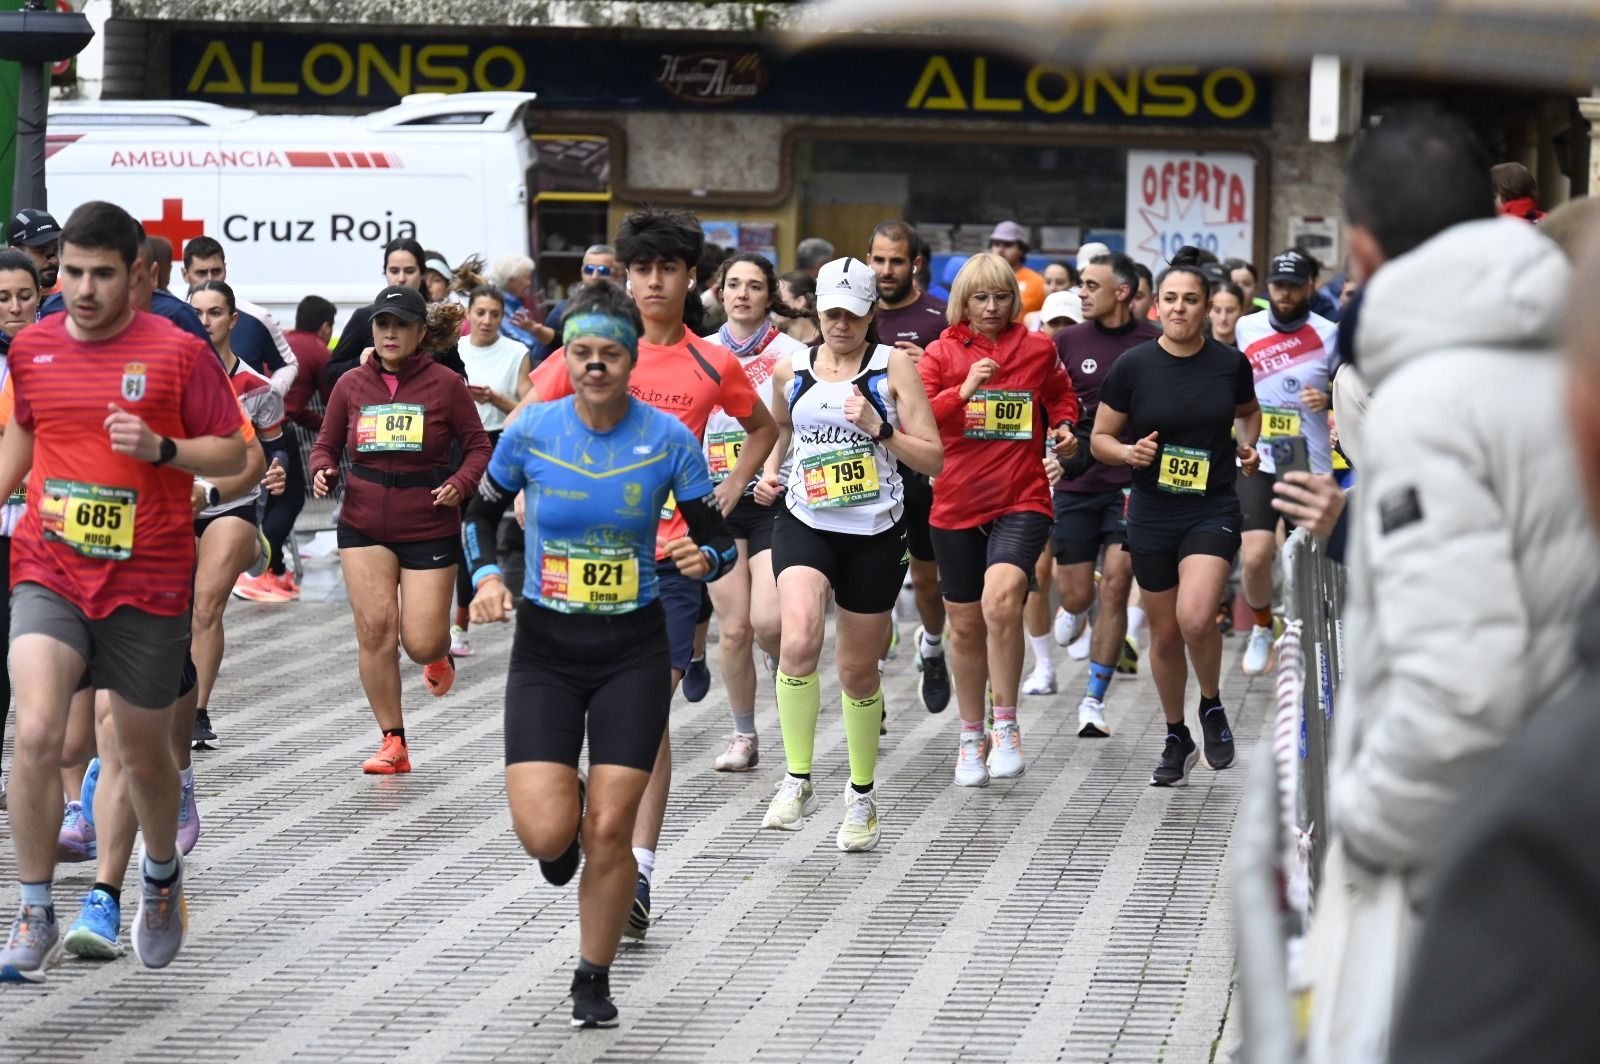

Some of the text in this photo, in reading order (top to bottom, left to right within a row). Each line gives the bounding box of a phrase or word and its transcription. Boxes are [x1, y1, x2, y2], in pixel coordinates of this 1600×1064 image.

[186, 40, 526, 97] ALONSO
[905, 55, 1256, 119] ALONSO
[110, 150, 283, 168] AMBULANCIA
[1142, 159, 1247, 224] OFERTA
[222, 211, 418, 248] Cruz Roja
[1261, 352, 1293, 374] FER
[995, 402, 1023, 420] 607
[385, 415, 413, 431] 847
[996, 422, 1020, 431] Raquel
[1269, 416, 1291, 431] 851
[391, 434, 408, 443] Nelli
[831, 460, 865, 484] 795
[1168, 457, 1199, 478] 934
[841, 483, 865, 495] ELENA
[76, 502, 122, 530] 685
[84, 532, 112, 546] HUGO
[582, 562, 623, 587] 821
[590, 591, 618, 602] Elena
